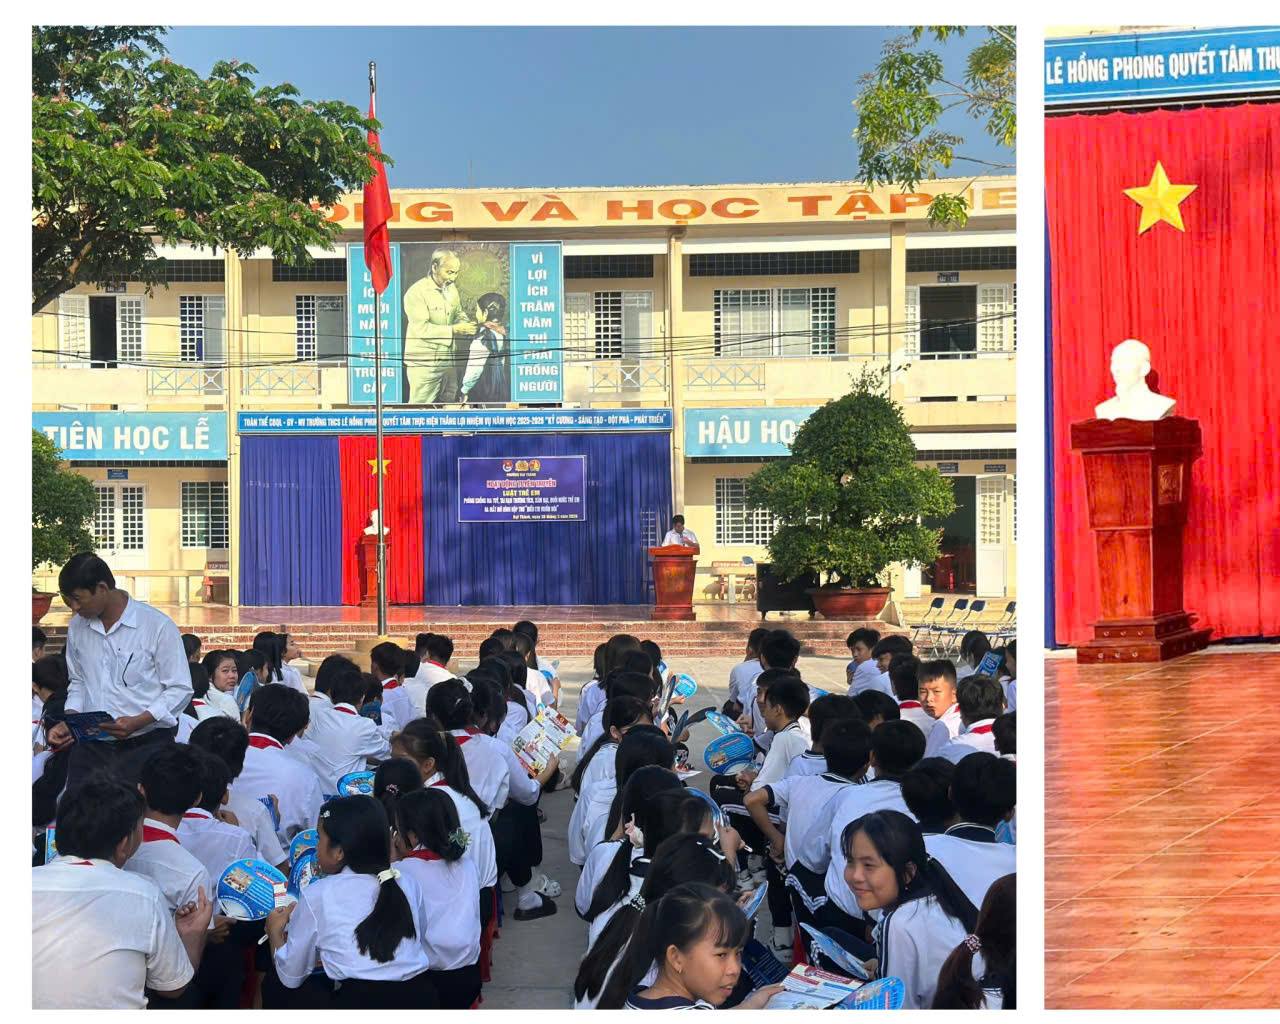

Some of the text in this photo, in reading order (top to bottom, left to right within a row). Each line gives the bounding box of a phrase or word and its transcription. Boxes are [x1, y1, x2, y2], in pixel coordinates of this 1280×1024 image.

[1046, 56, 1063, 85] LÊ
[1112, 54, 1164, 80] PHONG
[1169, 44, 1215, 79] QUYẾT
[1219, 45, 1252, 73] TÂM
[480, 194, 578, 222] VÀ
[606, 198, 760, 225] HỌC
[788, 189, 933, 220] TẬP
[531, 251, 543, 264] VÌ
[42, 416, 210, 456] TIÊN HỌC LỄ
[699, 415, 751, 450] HẬU
